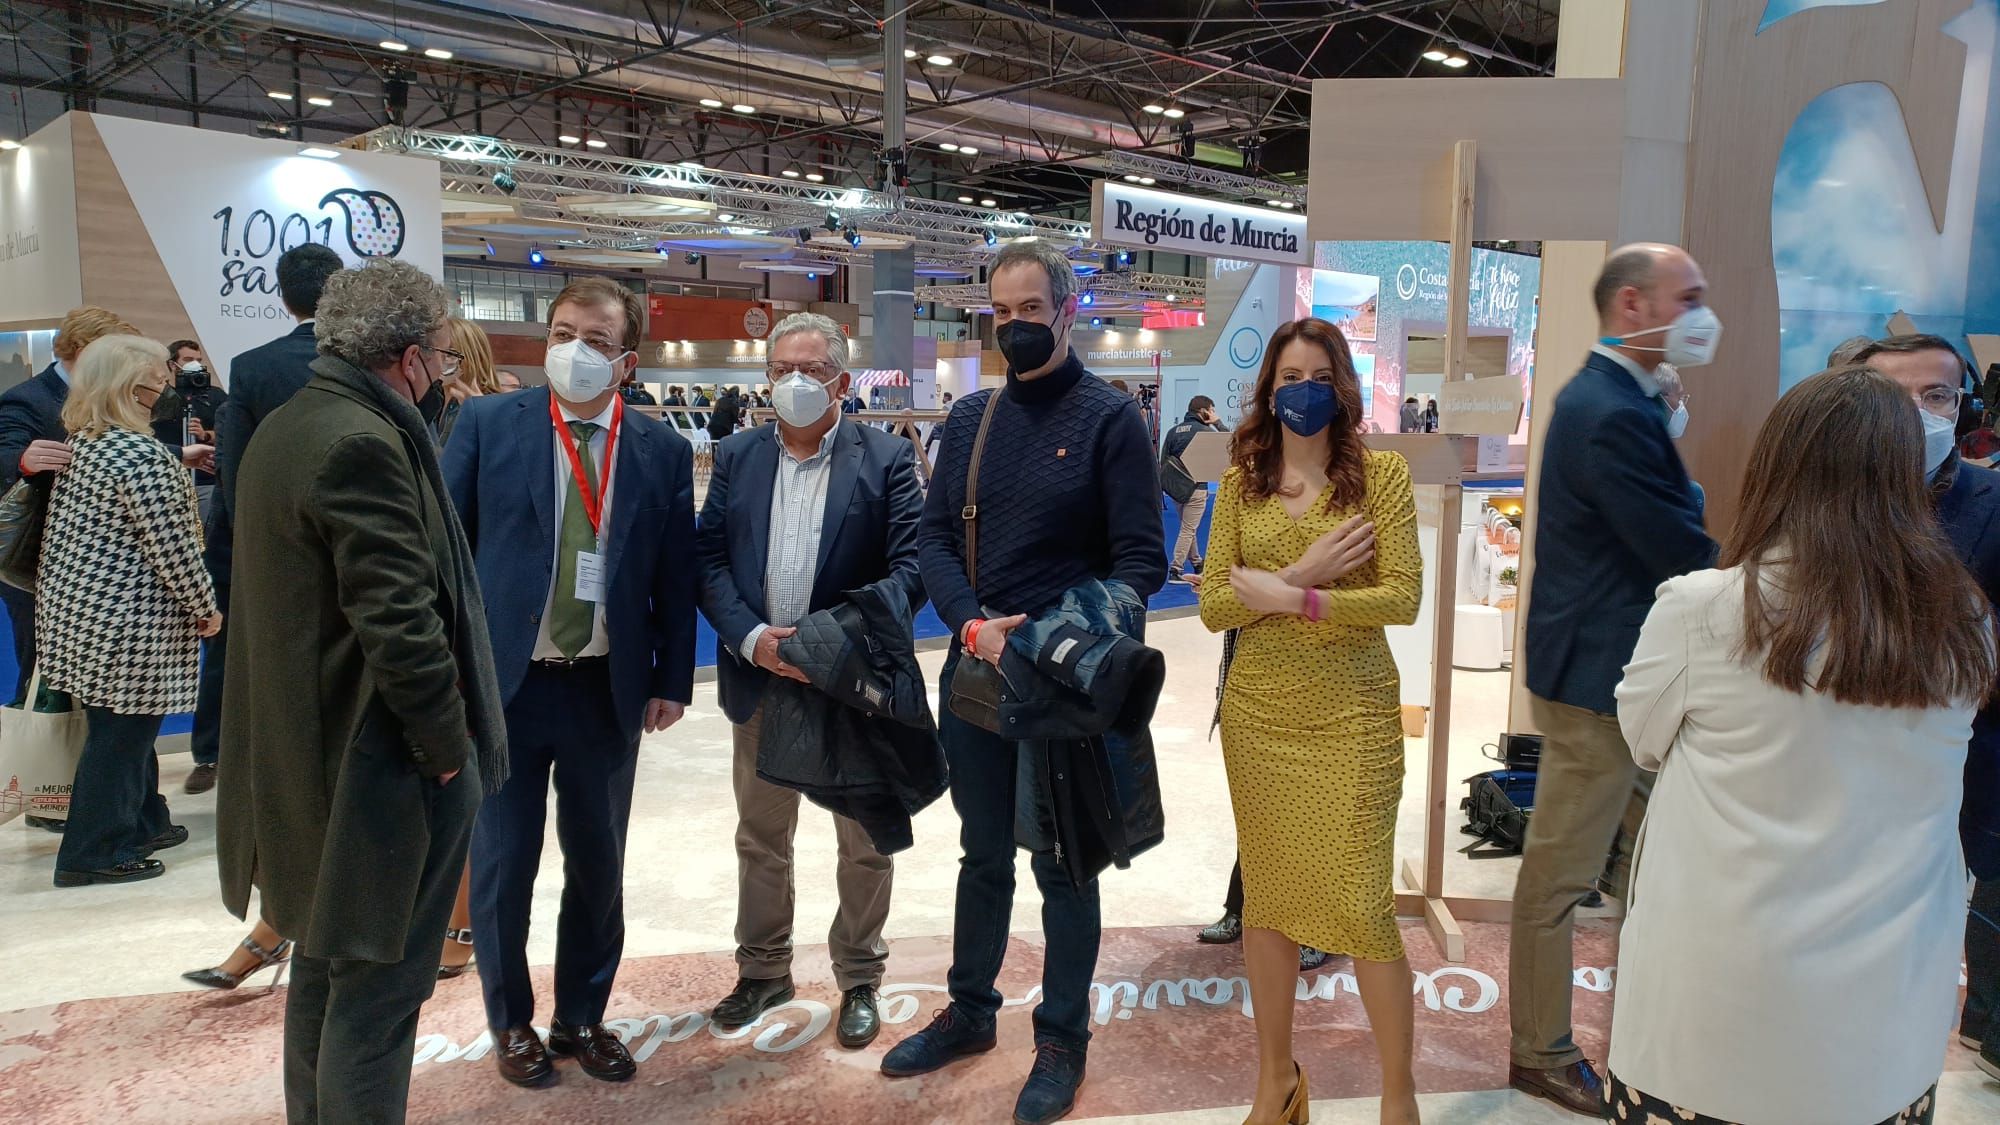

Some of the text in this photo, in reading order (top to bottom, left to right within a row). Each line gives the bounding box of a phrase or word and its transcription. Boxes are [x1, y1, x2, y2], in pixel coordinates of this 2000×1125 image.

[1115, 199, 1298, 253] Región de Murcia
[1420, 266, 1447, 287] Costa
[1489, 282, 1519, 318] feliz
[220, 303, 290, 320] REGIÓN
[42, 784, 73, 794] MEJOR
